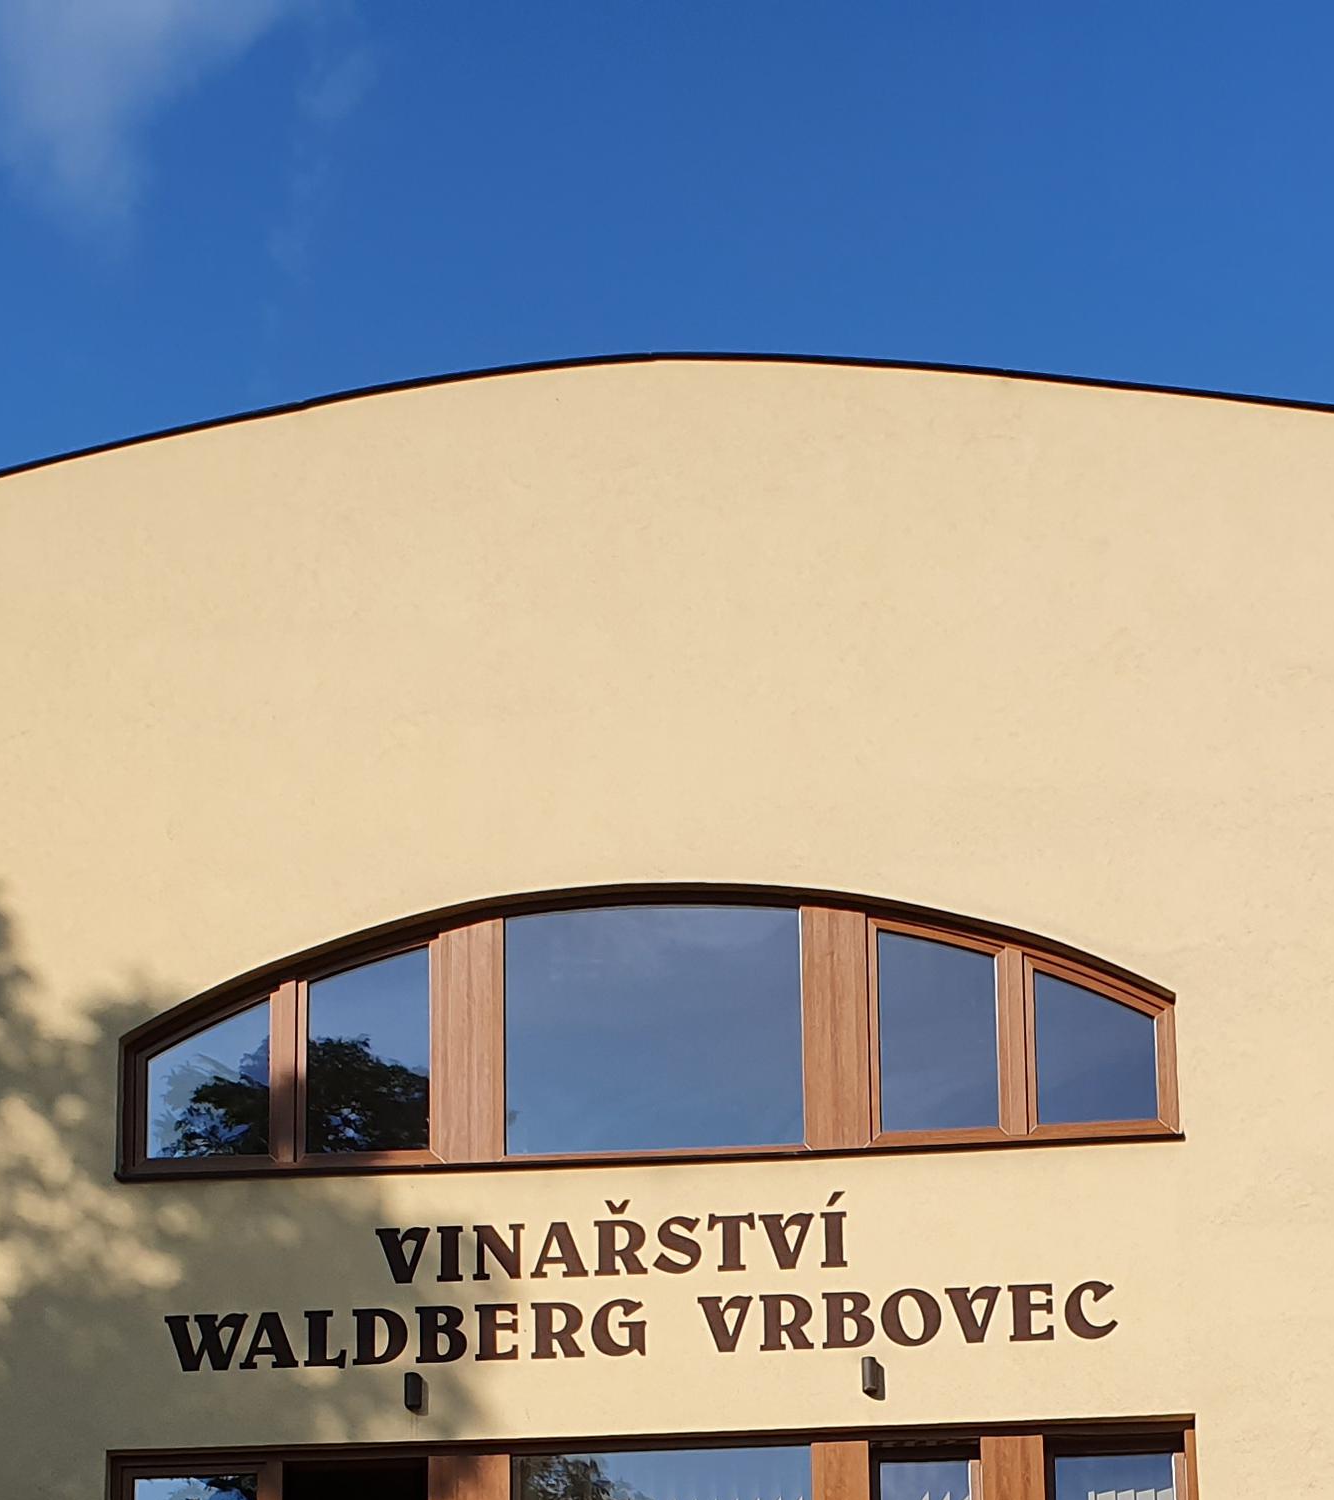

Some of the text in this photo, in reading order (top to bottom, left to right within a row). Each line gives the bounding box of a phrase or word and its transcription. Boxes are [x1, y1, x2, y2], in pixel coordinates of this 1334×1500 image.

[375, 1191, 848, 1285] VINAŘSTVÍ
[164, 1280, 1119, 1373] WALDBERG VRBOVEC
